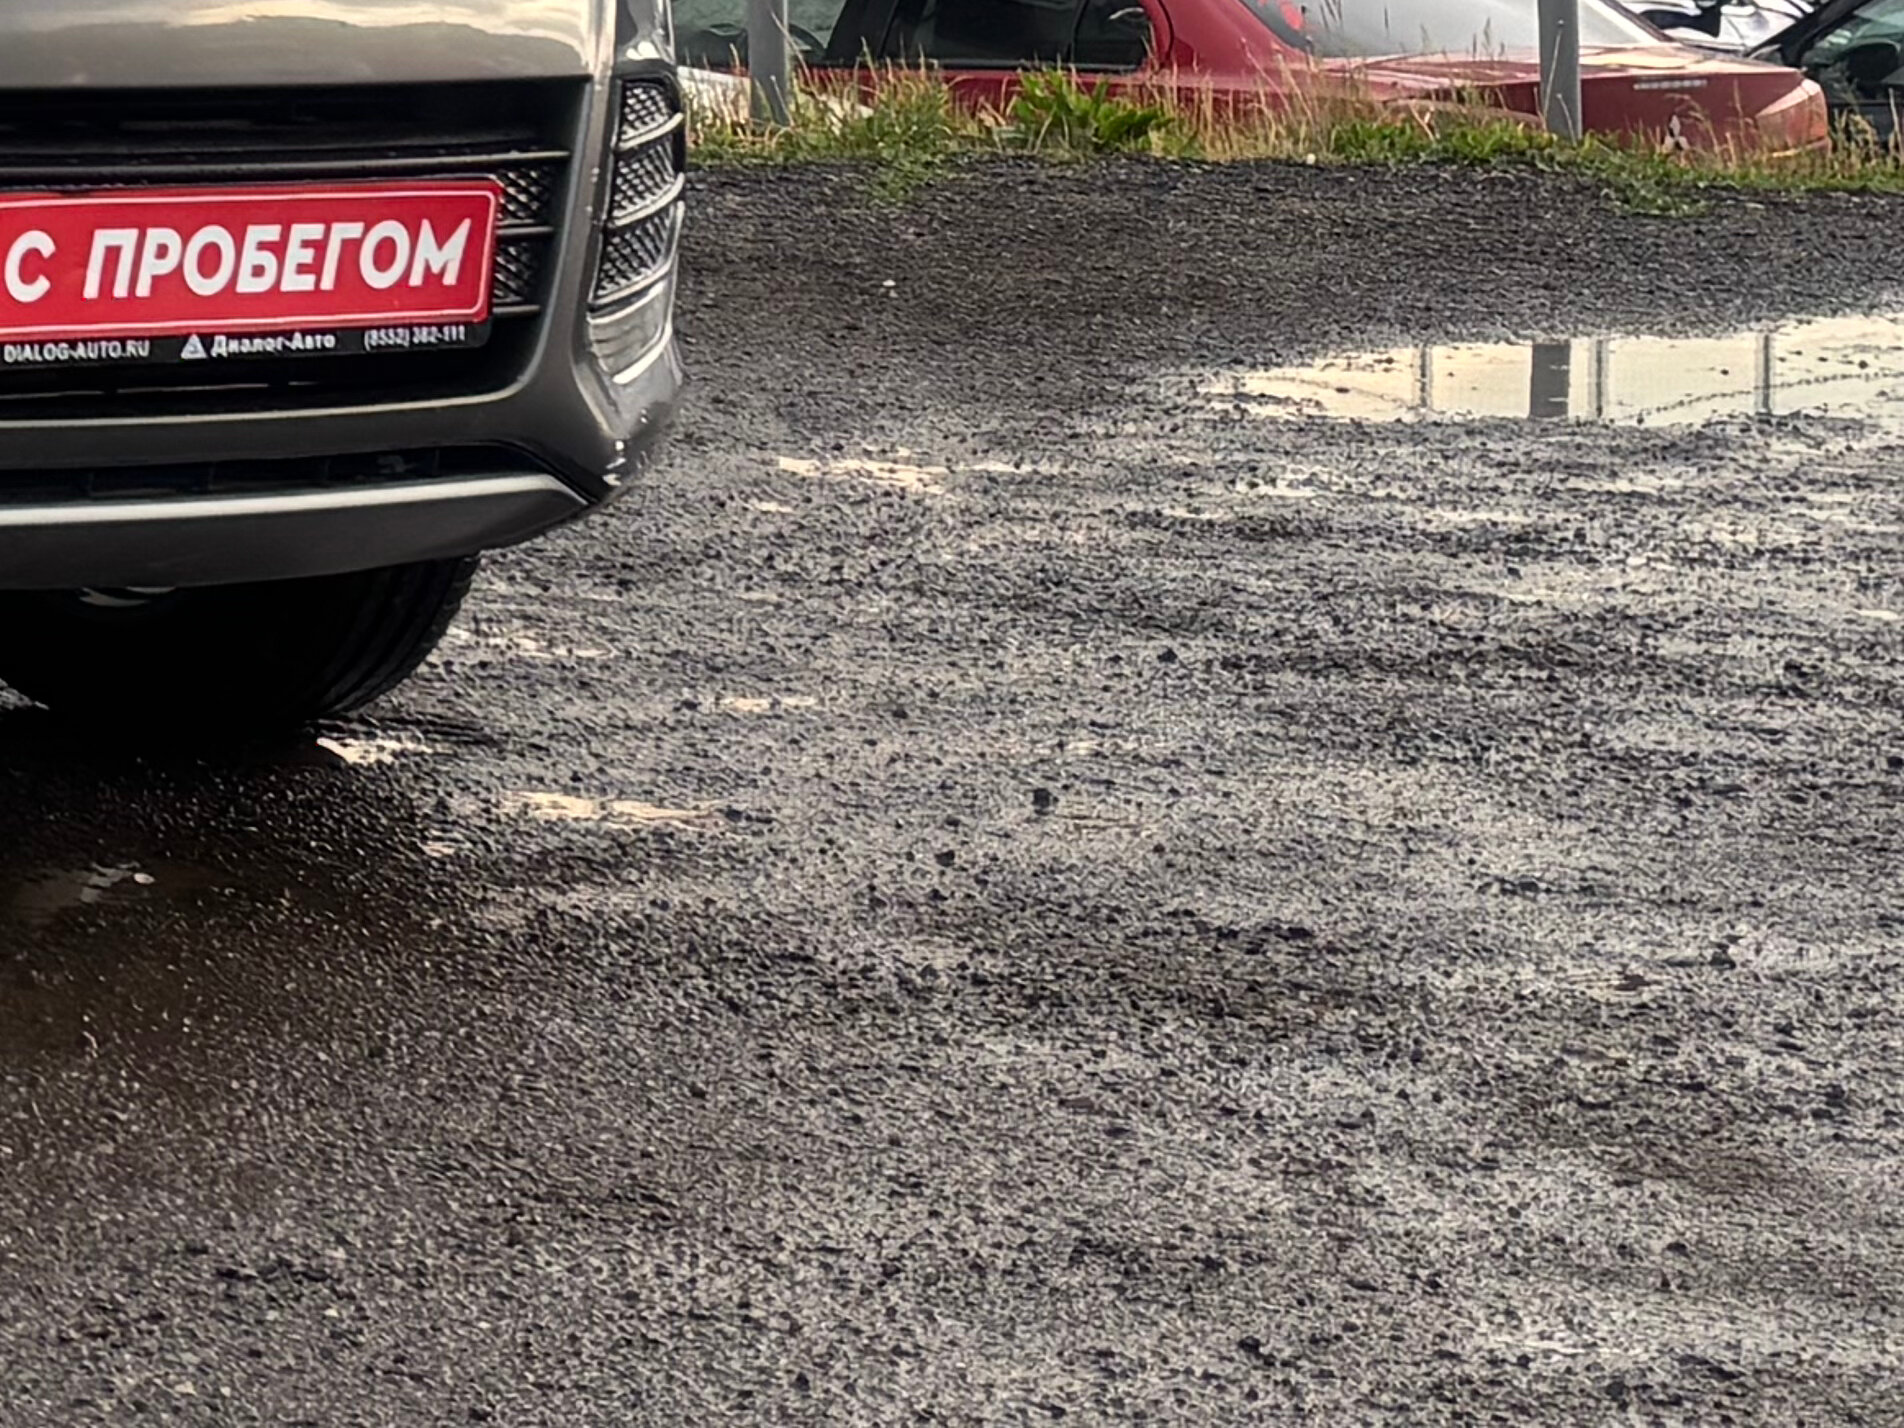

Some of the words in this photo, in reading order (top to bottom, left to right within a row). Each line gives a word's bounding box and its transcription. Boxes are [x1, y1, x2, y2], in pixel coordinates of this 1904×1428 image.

[4, 230, 56, 303] С
[83, 218, 471, 299] ПРОБЕГОМ
[4, 340, 150, 363] DIALOG-AUTO.RU
[210, 331, 337, 358] Диалог-Авто
